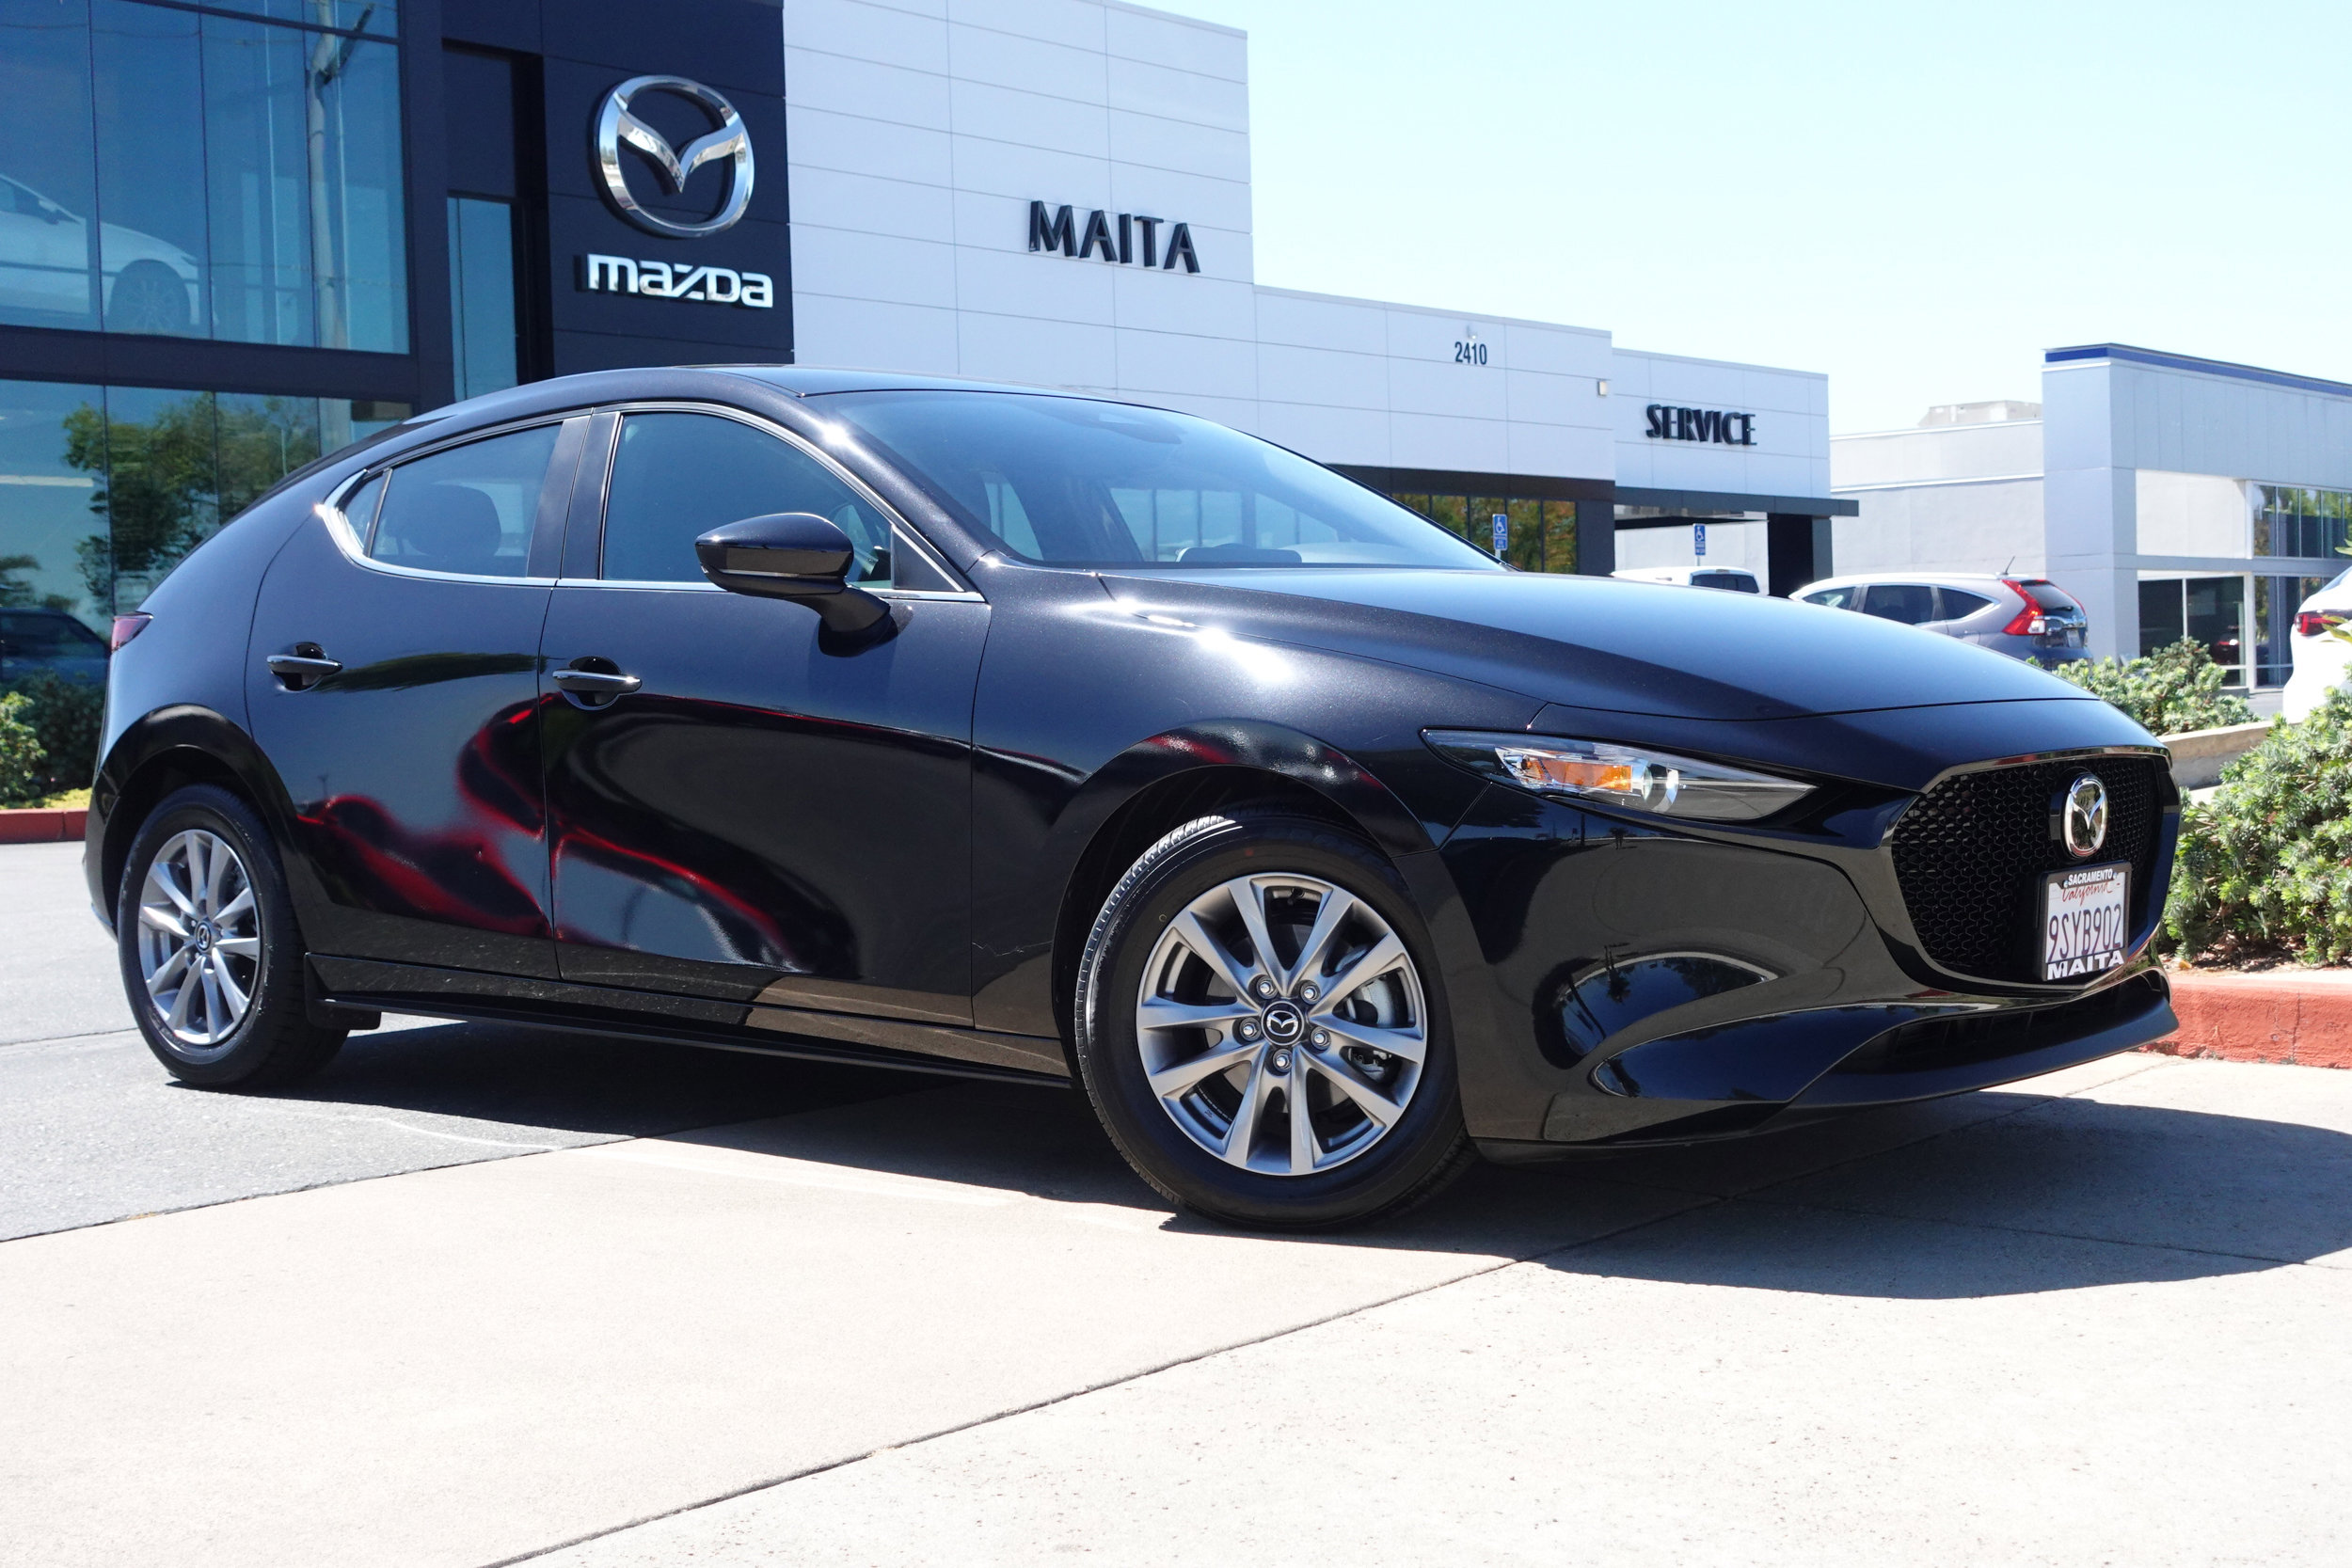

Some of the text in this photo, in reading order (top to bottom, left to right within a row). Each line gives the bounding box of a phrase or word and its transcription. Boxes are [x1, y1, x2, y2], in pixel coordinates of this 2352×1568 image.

[1029, 200, 1200, 274] MAITA
[1454, 341, 1487, 365] 2410
[1645, 404, 1757, 446] SERVICE
[2068, 868, 2113, 886] SACRAMENTO
[2048, 904, 2122, 962] 9SYB902
[2047, 950, 2124, 980] MAITA
